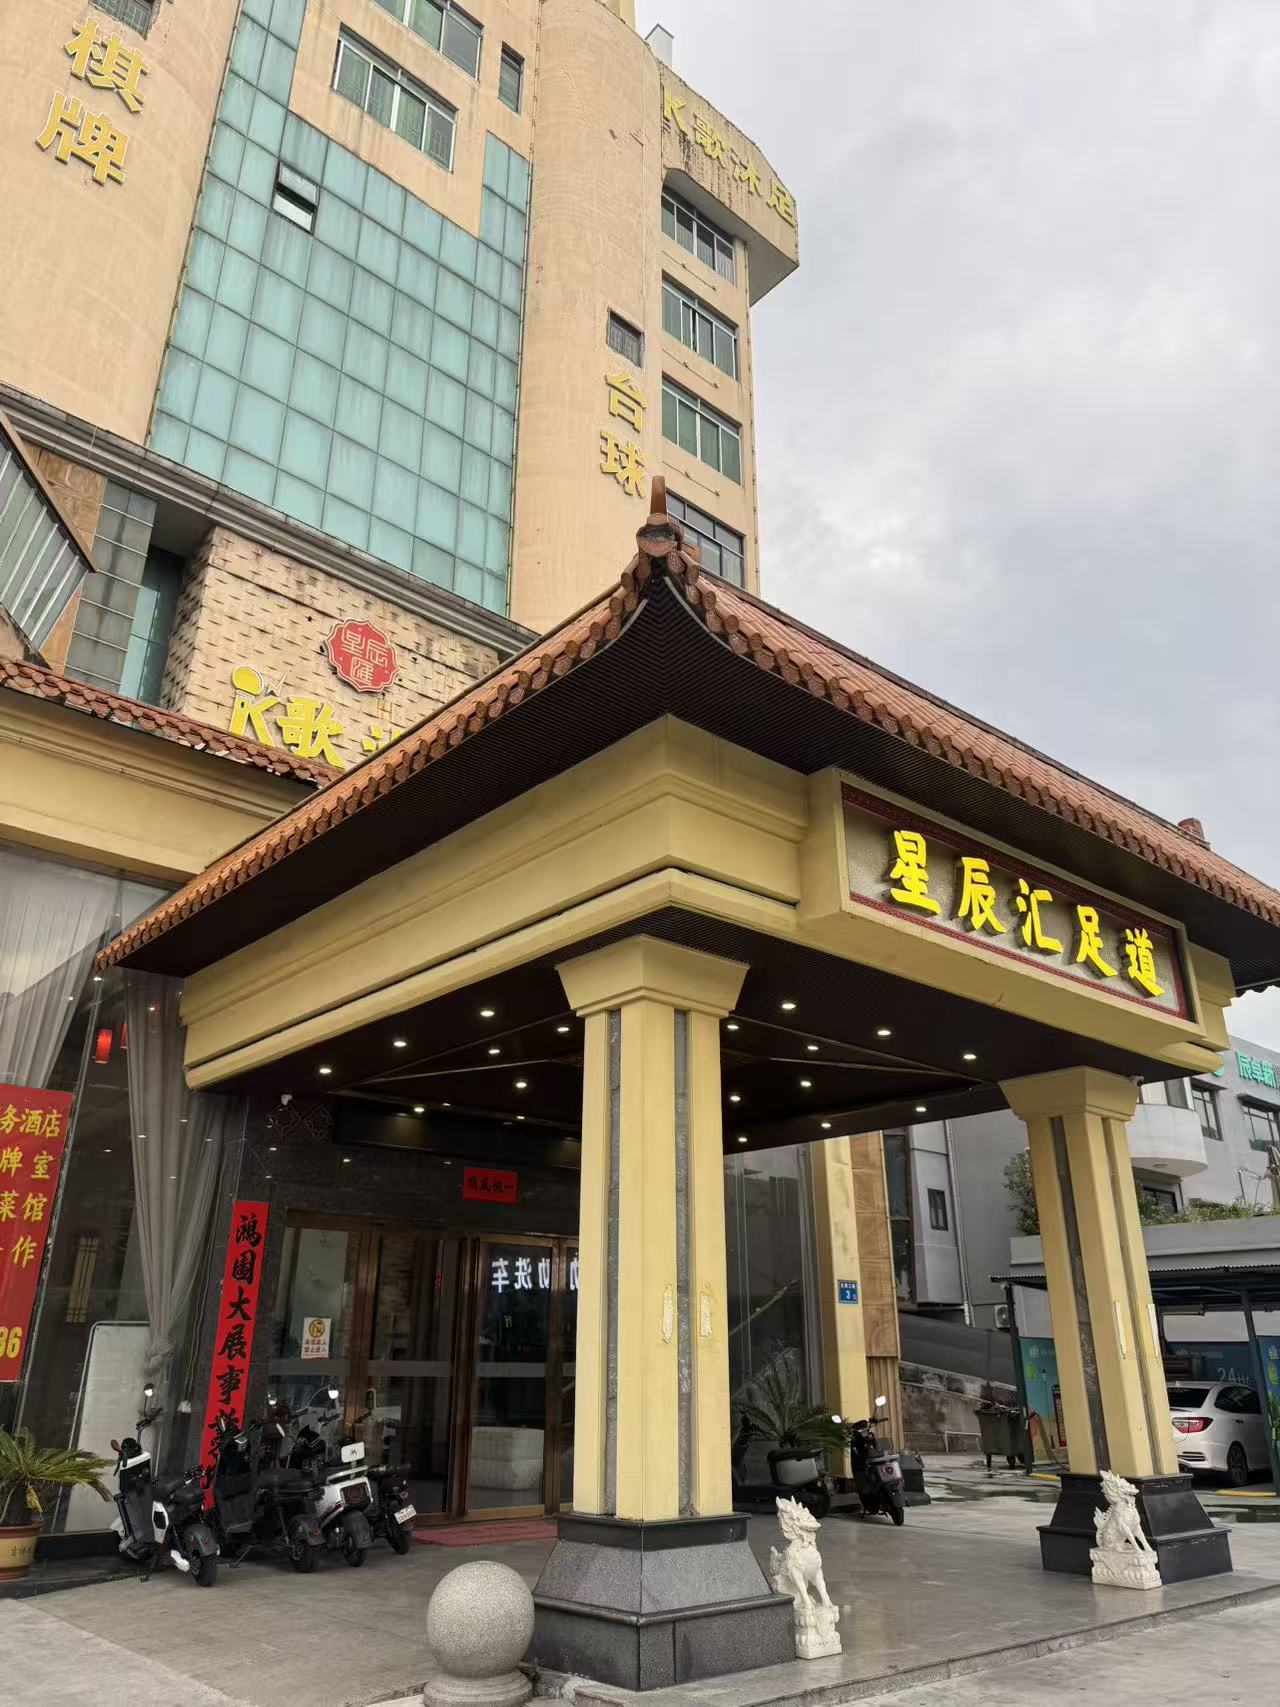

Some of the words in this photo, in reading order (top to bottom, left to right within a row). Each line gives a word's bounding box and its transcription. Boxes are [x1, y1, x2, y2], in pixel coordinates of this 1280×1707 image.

[35, 16, 151, 186] 棋牌
[663, 84, 797, 227] K歌沐足
[600, 368, 648, 498] 台球
[889, 829, 1166, 997] 星辰汇足道
[0, 1103, 62, 1138] 务酒店
